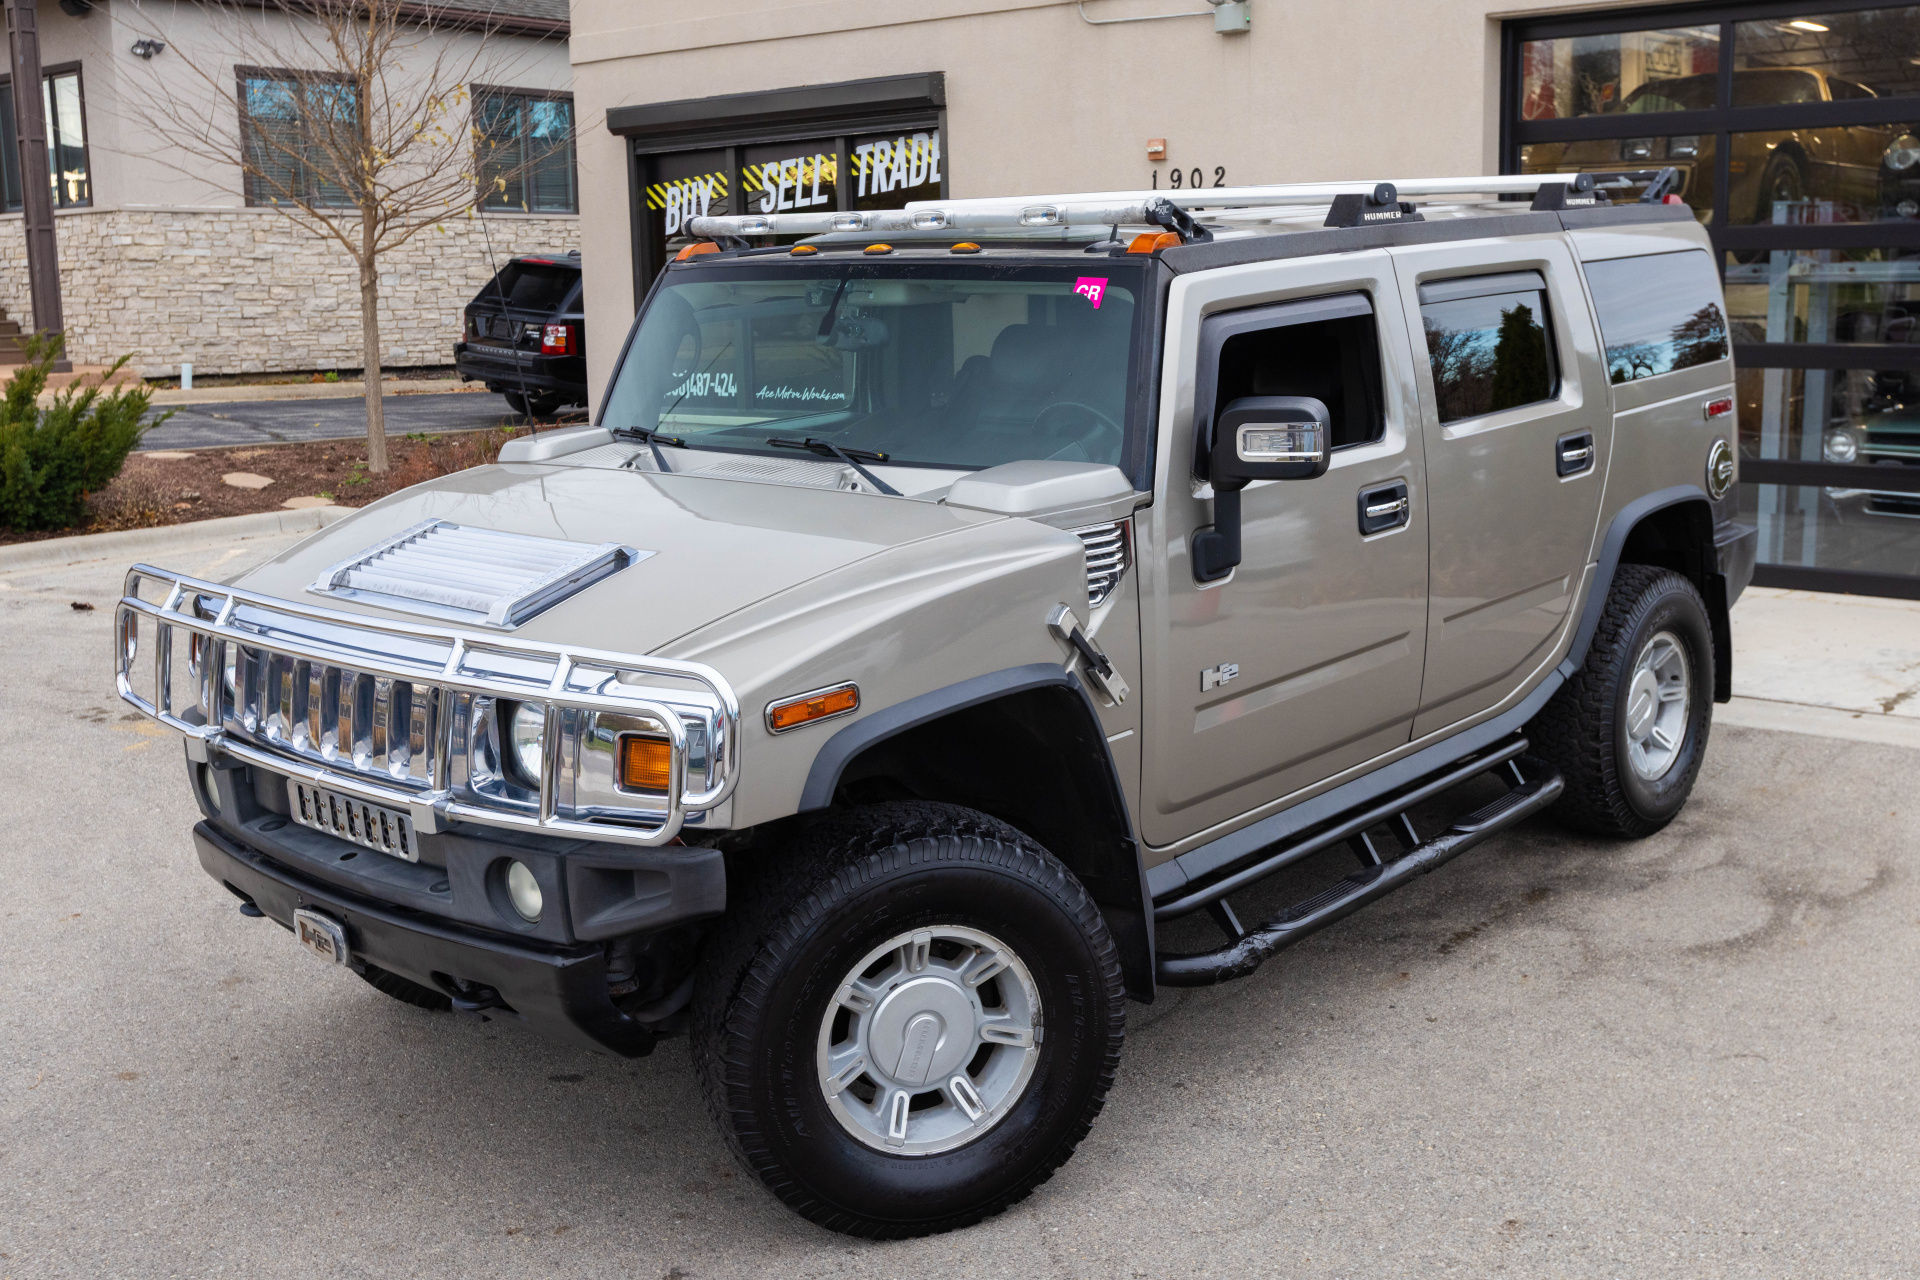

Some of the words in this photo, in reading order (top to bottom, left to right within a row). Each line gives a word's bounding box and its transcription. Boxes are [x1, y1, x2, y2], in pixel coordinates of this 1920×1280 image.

[665, 177, 715, 236] BUY
[760, 153, 828, 213] SELL
[855, 130, 941, 197] TRADE
[1152, 166, 1226, 190] 1902
[1364, 210, 1402, 221] HUMMER
[1200, 662, 1239, 692] H2
[299, 920, 333, 955] H2
